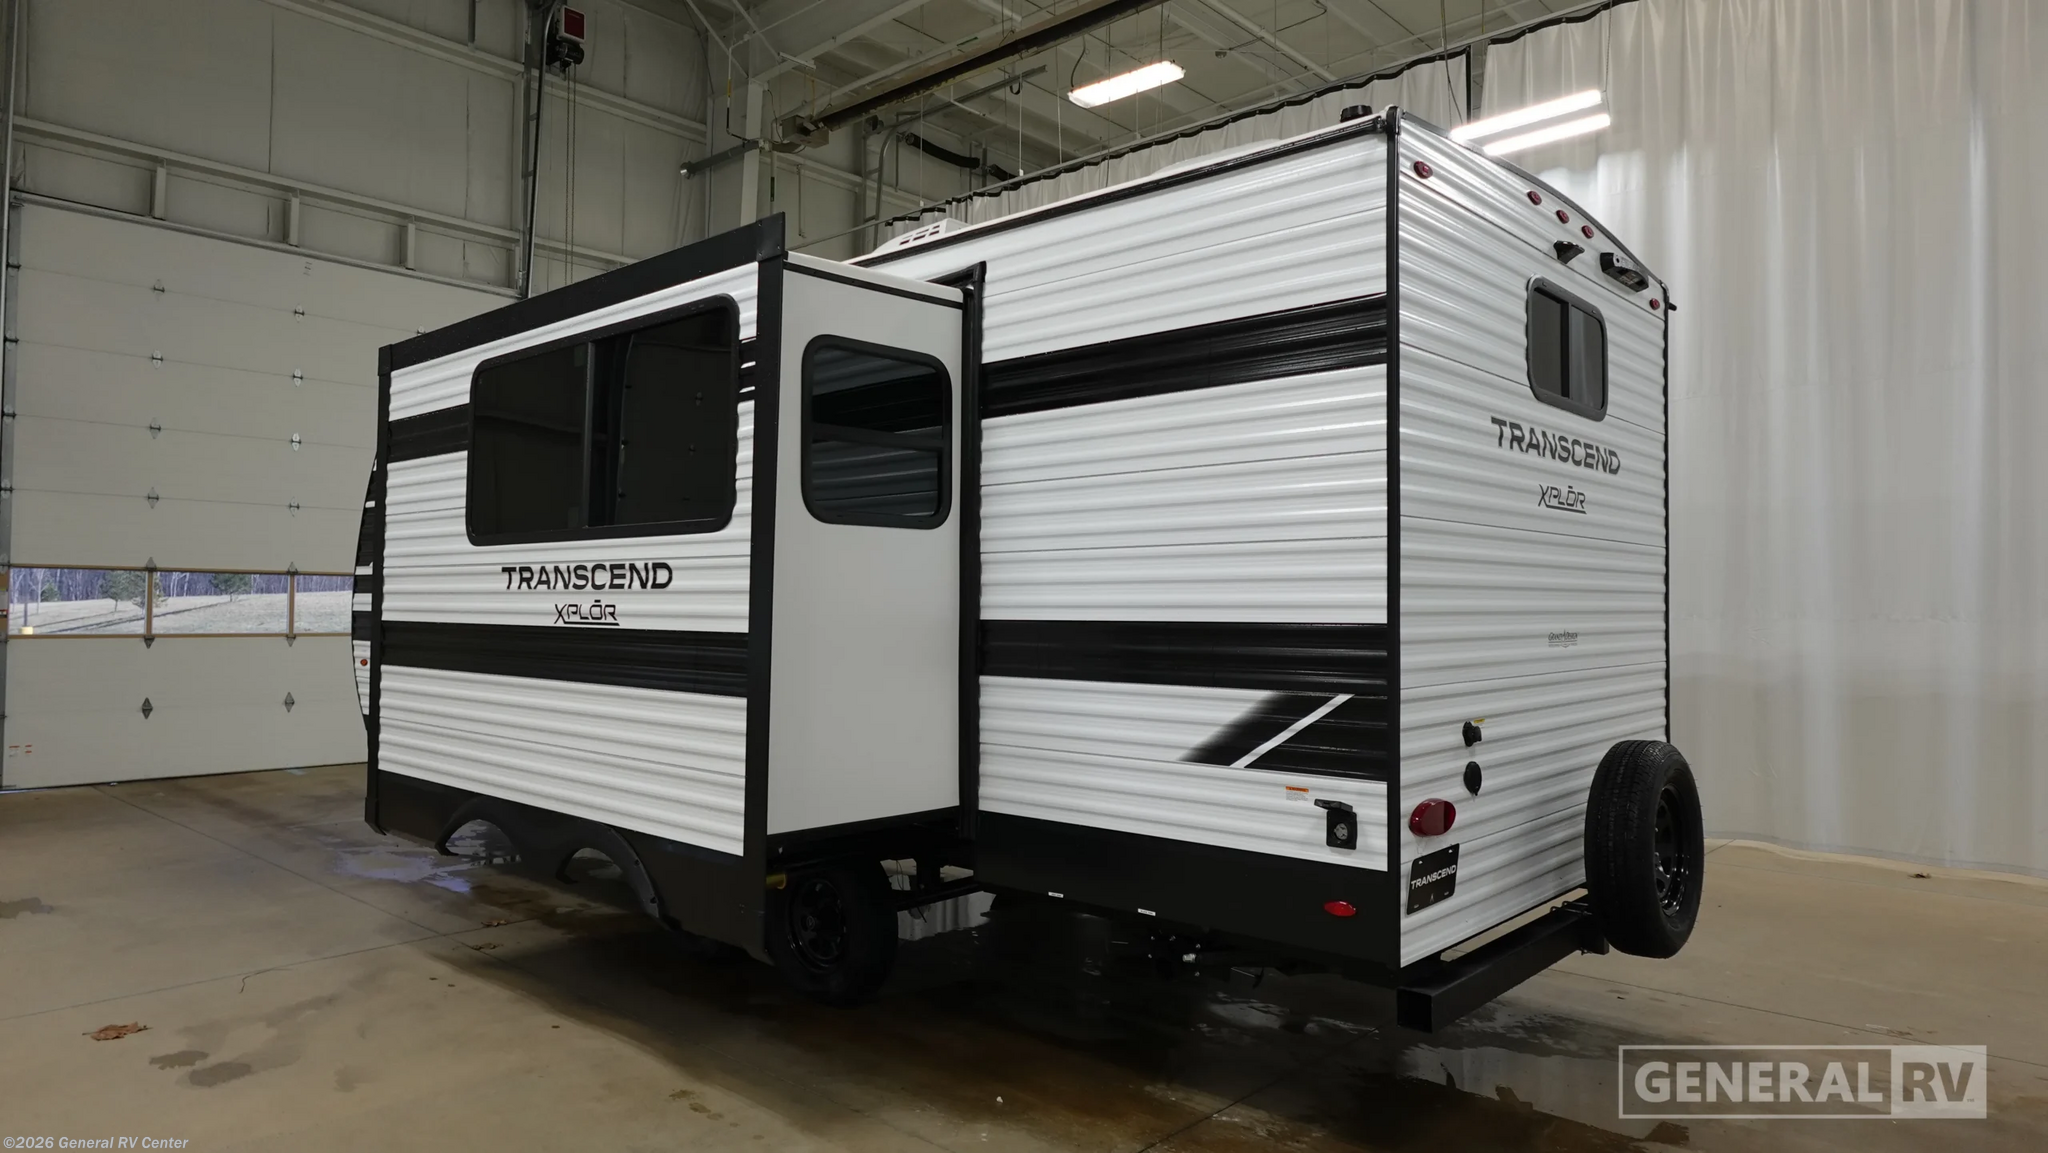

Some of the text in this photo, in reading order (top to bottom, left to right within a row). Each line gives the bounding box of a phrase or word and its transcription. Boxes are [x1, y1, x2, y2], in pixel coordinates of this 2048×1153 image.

[1490, 416, 1621, 475] TRANSCEND
[501, 562, 673, 590] TRANSCEND
[1411, 865, 1456, 890] TRANSCEND
